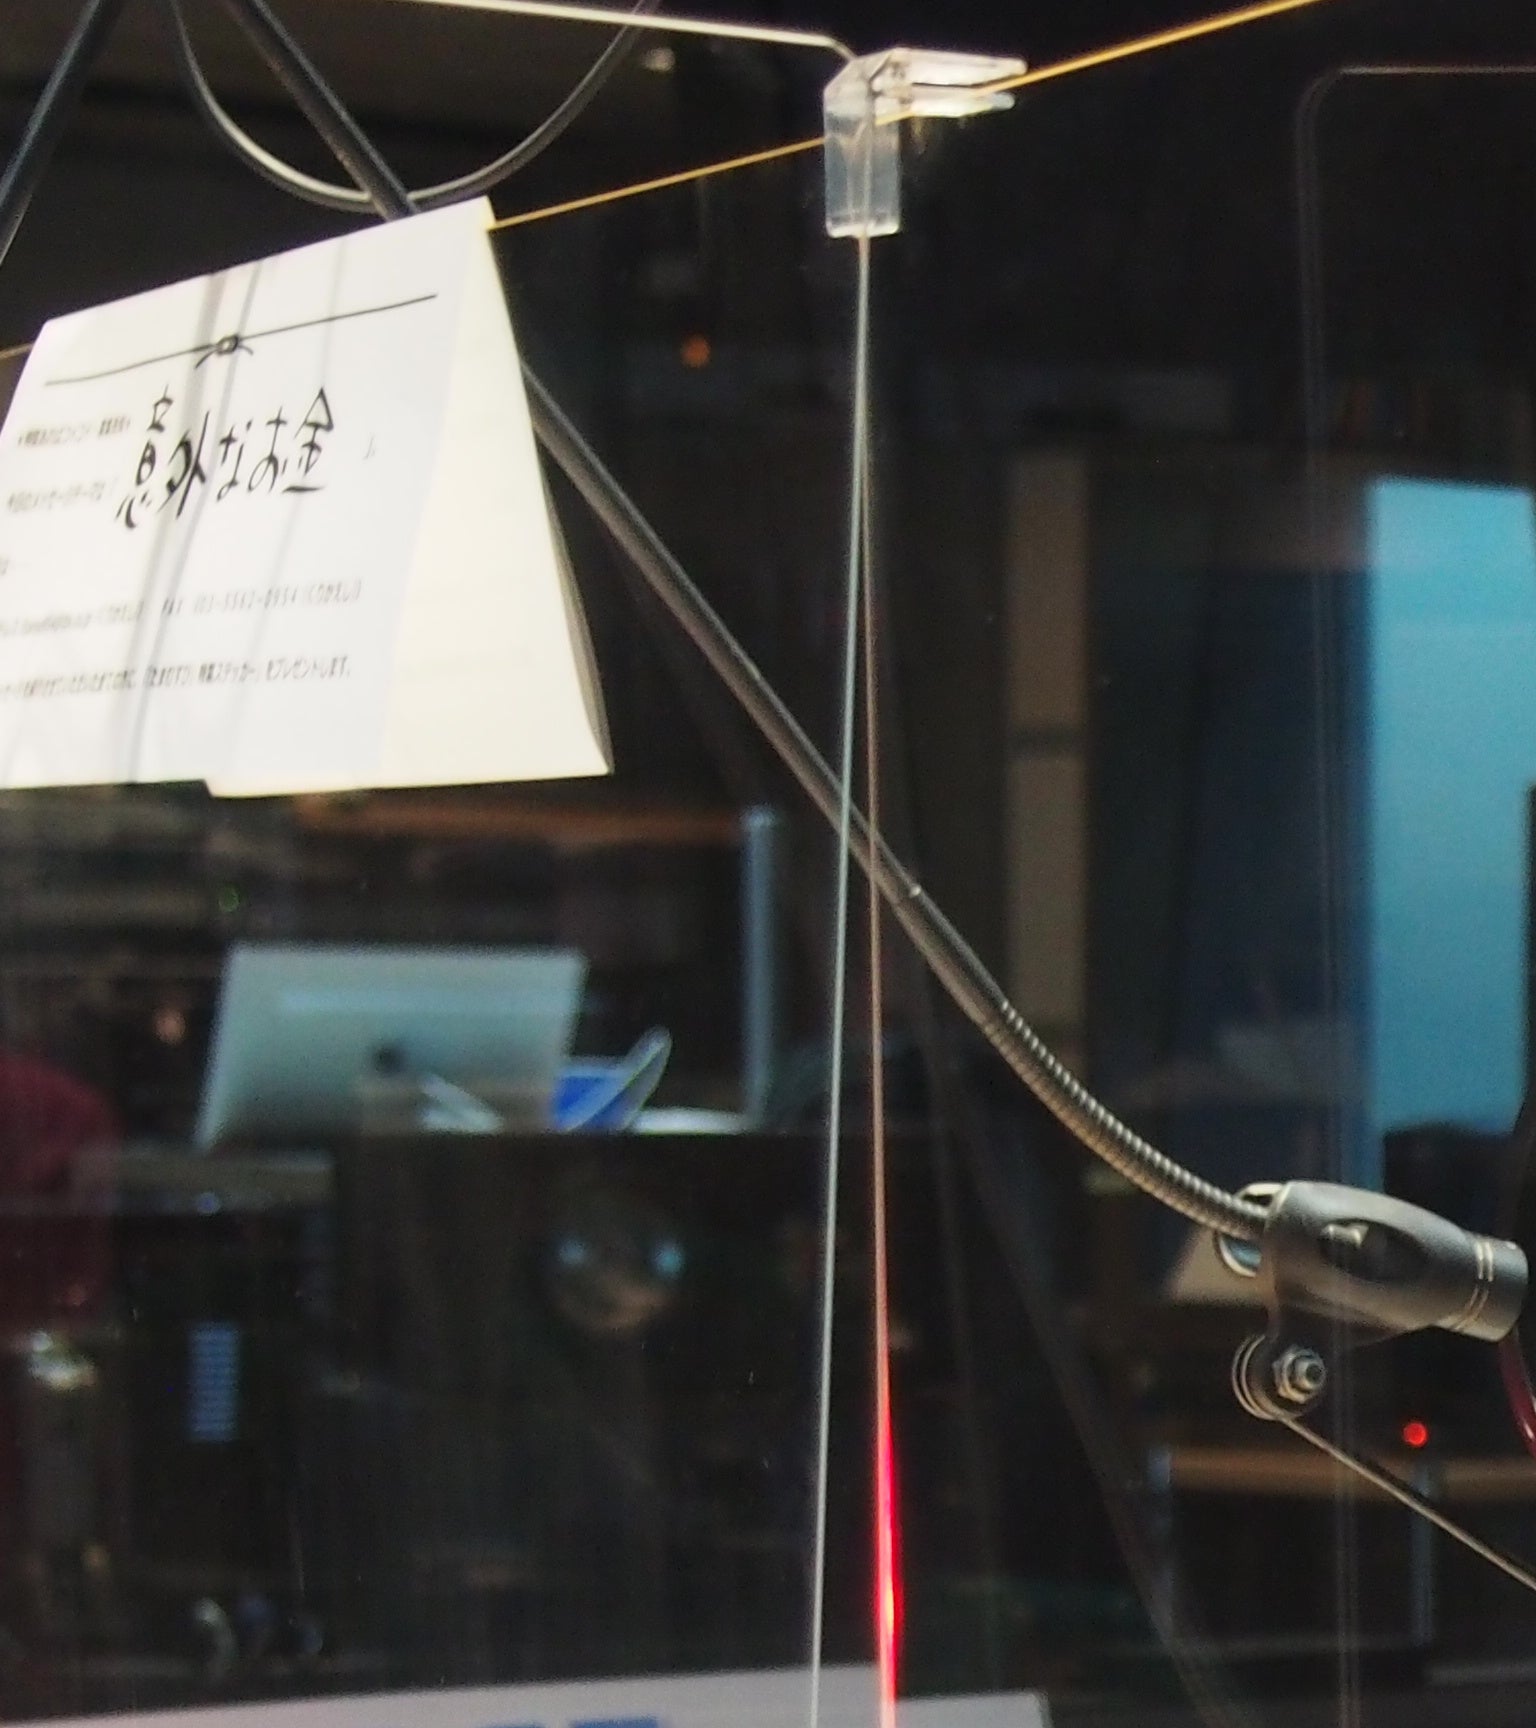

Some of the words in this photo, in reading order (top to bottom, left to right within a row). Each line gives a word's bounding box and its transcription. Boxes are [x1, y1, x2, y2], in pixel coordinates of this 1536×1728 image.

[115, 385, 334, 529] 意外なお金
